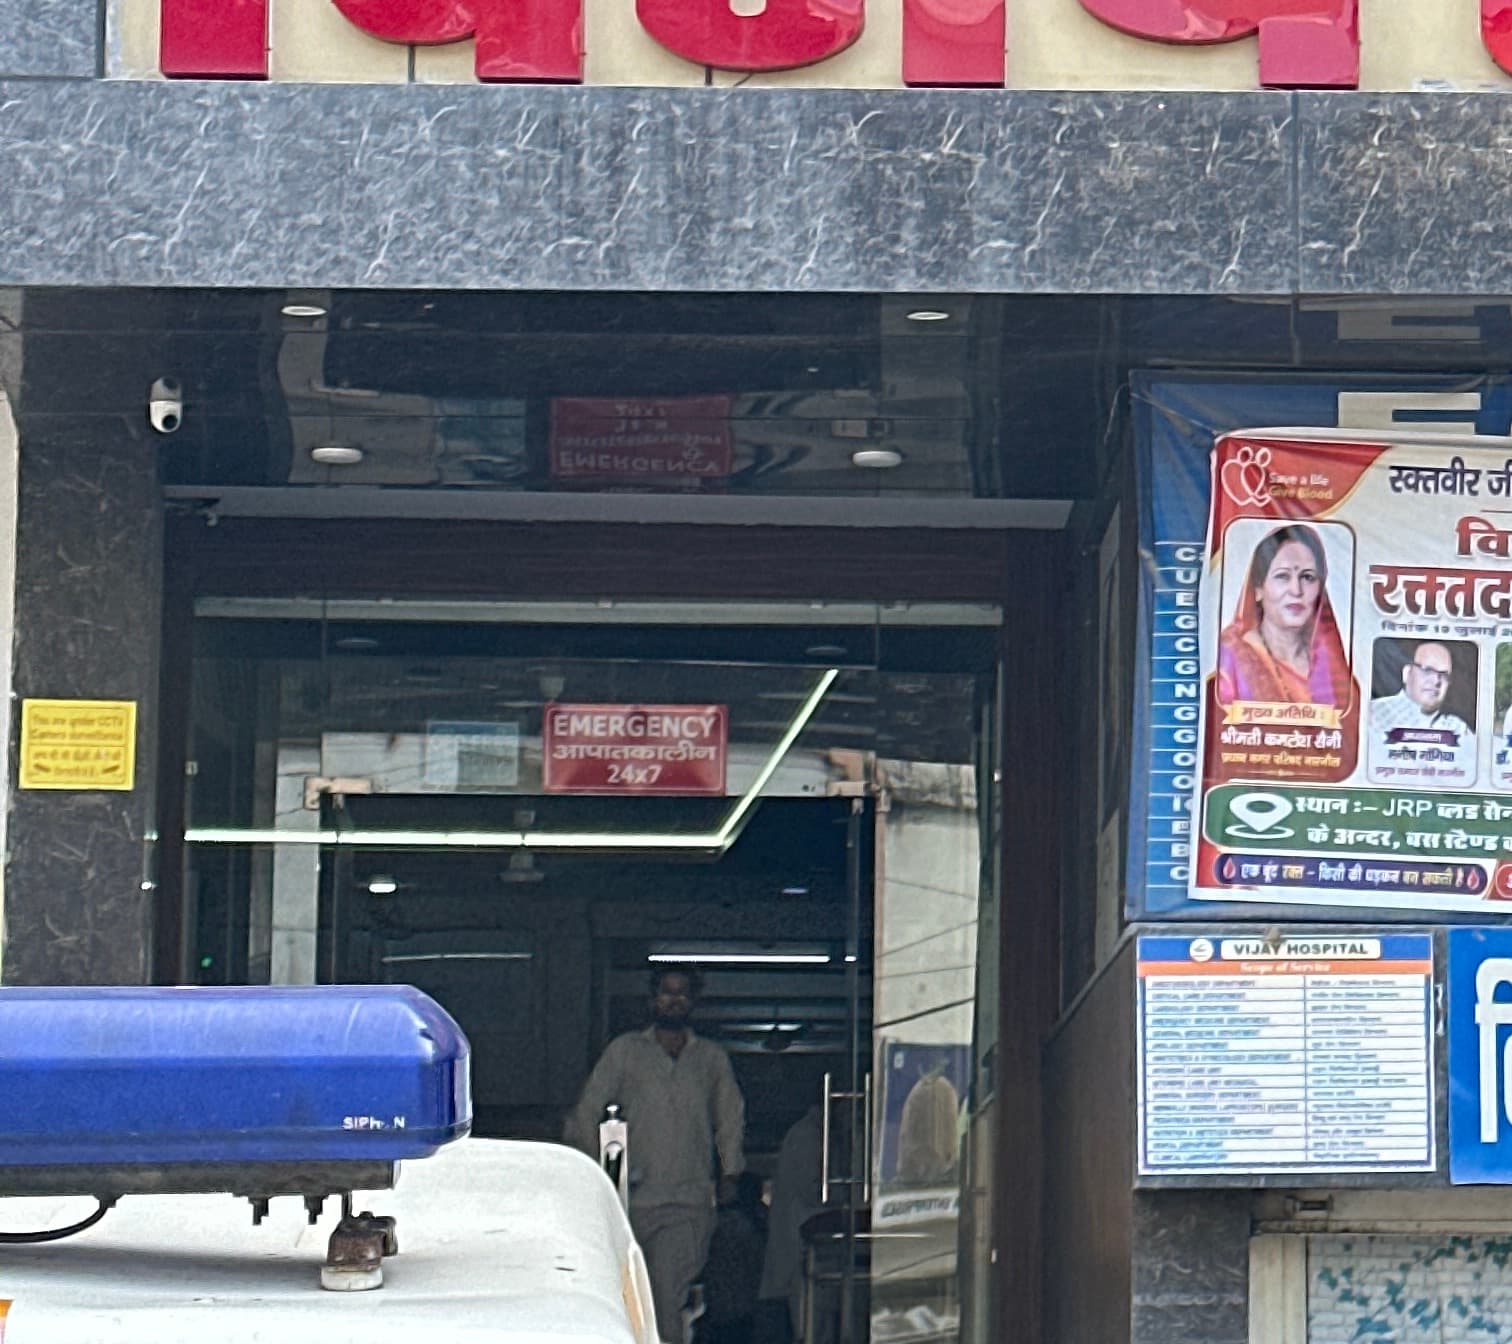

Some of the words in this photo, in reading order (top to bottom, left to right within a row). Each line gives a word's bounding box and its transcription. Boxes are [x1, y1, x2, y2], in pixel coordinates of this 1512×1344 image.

[554, 714, 716, 738] EMERGENCY
[1220, 725, 1262, 745] श्रीमती
[552, 741, 716, 762] आपातकालीन
[607, 764, 662, 784] 24x7
[1295, 794, 1348, 815] स्थान
[1383, 798, 1434, 817] JRP
[1307, 822, 1328, 844] के
[1347, 863, 1362, 882] की
[1233, 943, 1282, 956] VIJAY
[1287, 943, 1368, 955] HOSPITAL
